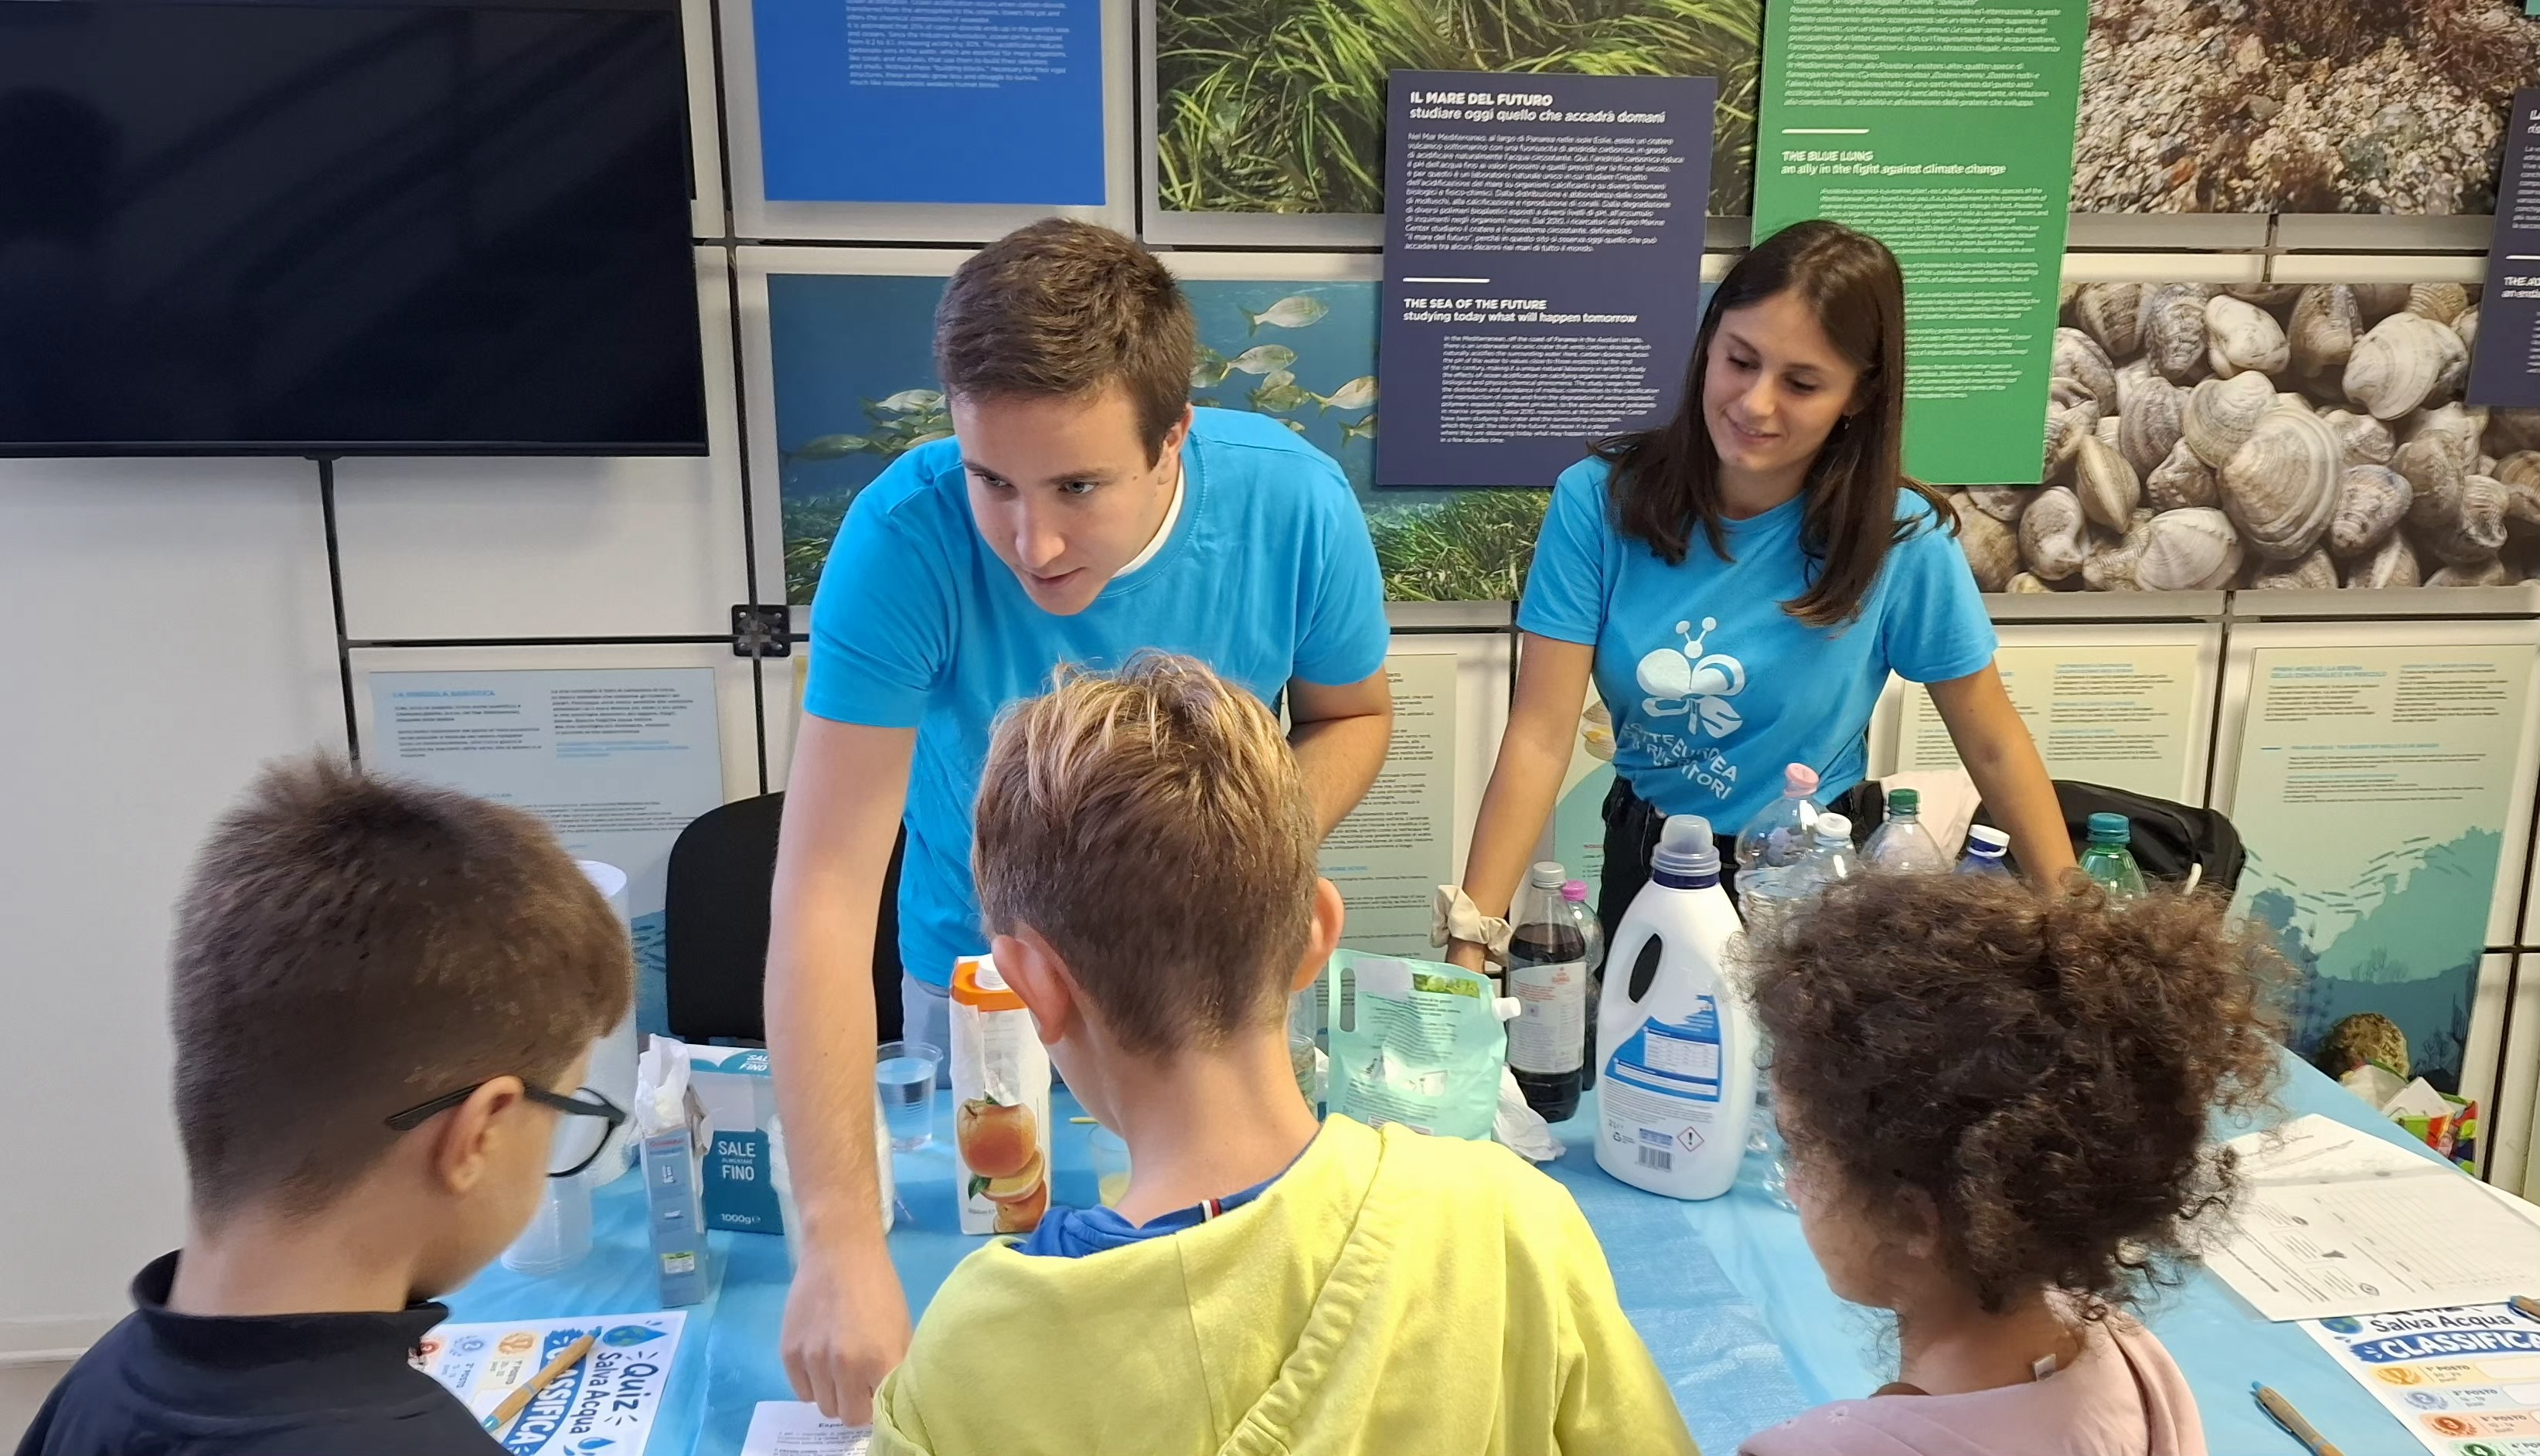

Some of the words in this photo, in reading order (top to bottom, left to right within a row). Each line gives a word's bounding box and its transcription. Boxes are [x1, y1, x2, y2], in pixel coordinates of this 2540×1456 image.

[1411, 92, 1423, 103] IL
[1426, 92, 1465, 104] MARE
[1468, 94, 1495, 104] DEL
[1497, 94, 1552, 106] FUTURO
[1410, 107, 1462, 119] studiare
[1465, 108, 1493, 121] oggi
[1496, 109, 1537, 122] quello
[1539, 109, 1562, 121] che
[1565, 111, 1615, 122] accadrà
[1617, 111, 1665, 123] domani
[1782, 151, 1806, 161] THE
[1807, 151, 1839, 161] BLUE
[1797, 164, 1818, 175] ally
[1833, 164, 1851, 174] the
[1881, 164, 1923, 175] against
[1404, 298, 1427, 308] THE
[1429, 299, 1452, 308] SEA
[1456, 299, 1473, 308] OF
[1475, 300, 1498, 309] THE
[1500, 300, 1547, 309] FUTURE
[1404, 311, 1451, 322] studying
[1454, 311, 1486, 323] today
[1488, 312, 1515, 321] what
[1518, 312, 1537, 321] will
[1540, 312, 1581, 324] happen
[1583, 314, 1637, 322] tomorrow
[1671, 737, 1738, 782] EUPEA
[739, 1063, 768, 1071] FINO
[718, 1141, 756, 1158] SALE
[722, 1164, 754, 1181] FINO
[721, 1213, 751, 1224] 1000g
[2370, 1317, 2438, 1332] Salva
[2438, 1315, 2515, 1329] Acqua
[588, 1352, 623, 1386] Salva
[509, 1346, 580, 1445] ASSIFICA
[612, 1362, 659, 1413] Quiz
[569, 1390, 611, 1434] Acqua
